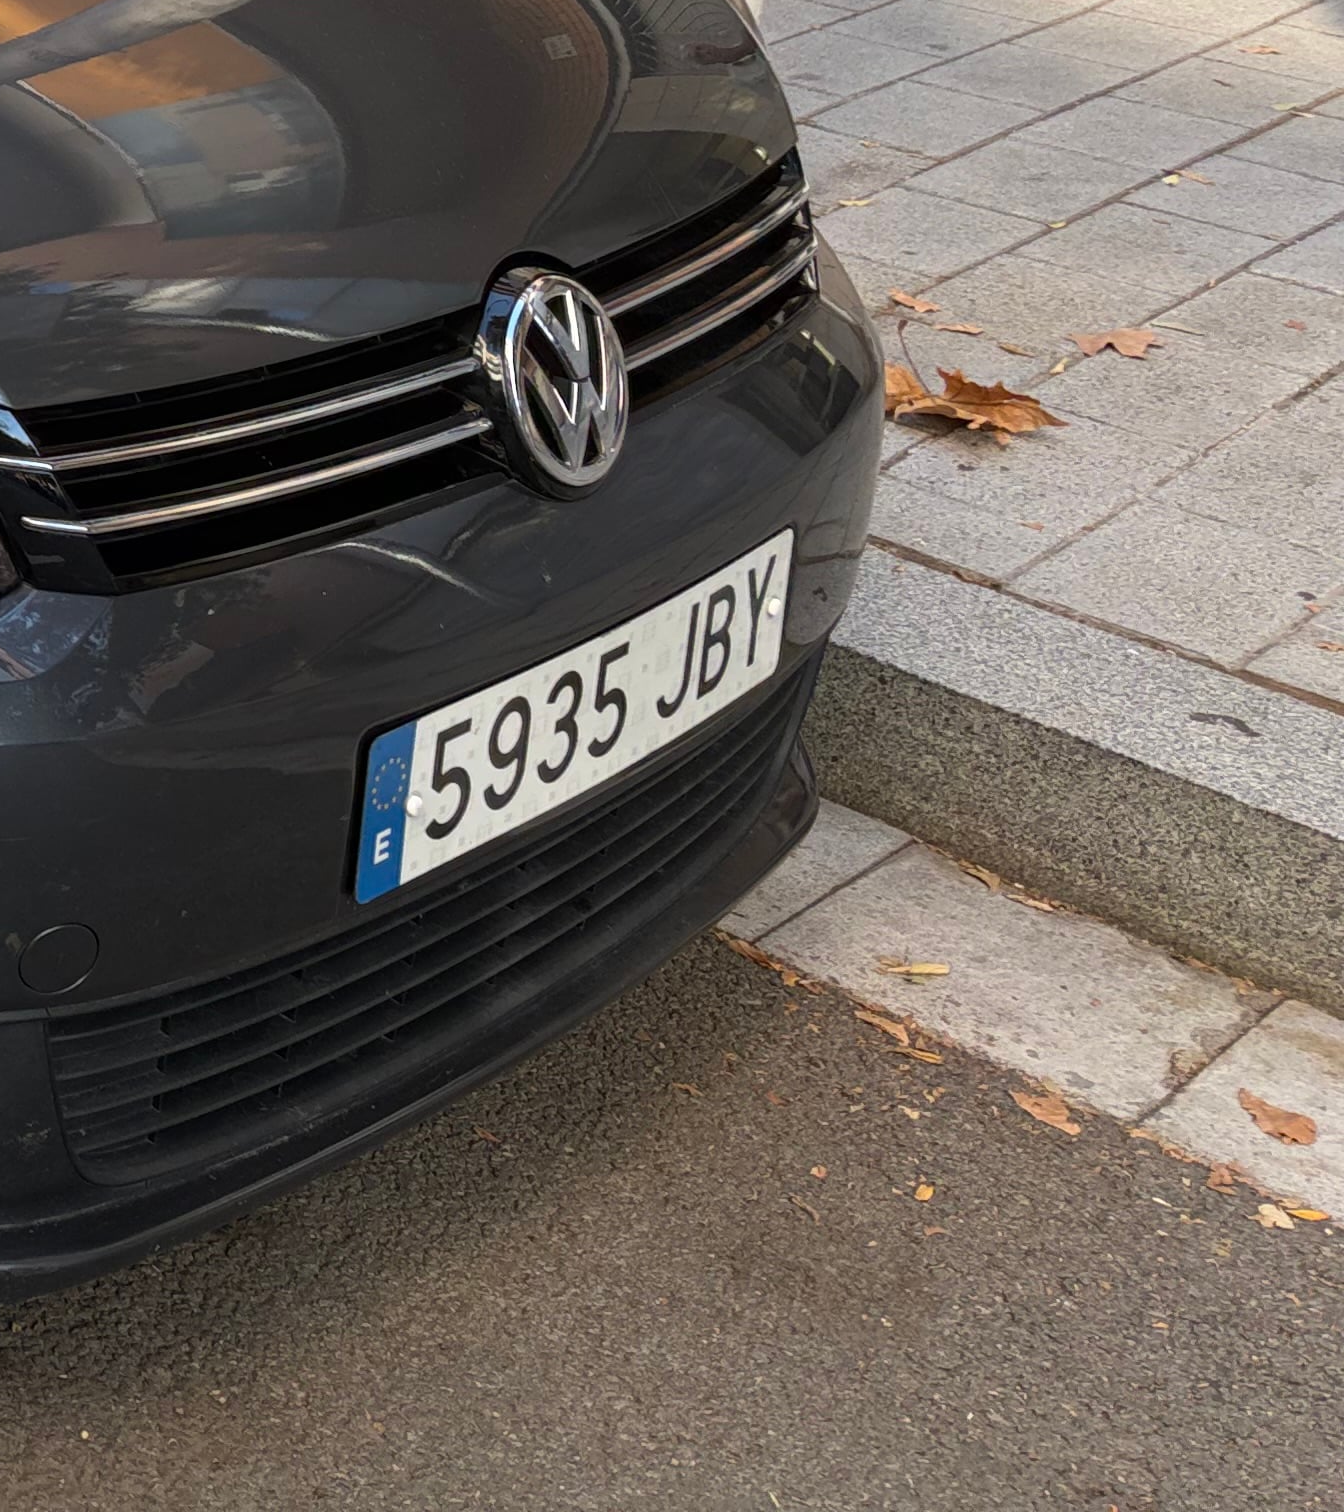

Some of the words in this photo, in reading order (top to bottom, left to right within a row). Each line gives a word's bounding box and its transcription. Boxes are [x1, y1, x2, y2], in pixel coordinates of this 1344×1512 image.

[425, 641, 630, 840] 5935
[657, 554, 777, 719] JBY
[373, 828, 391, 865] E
